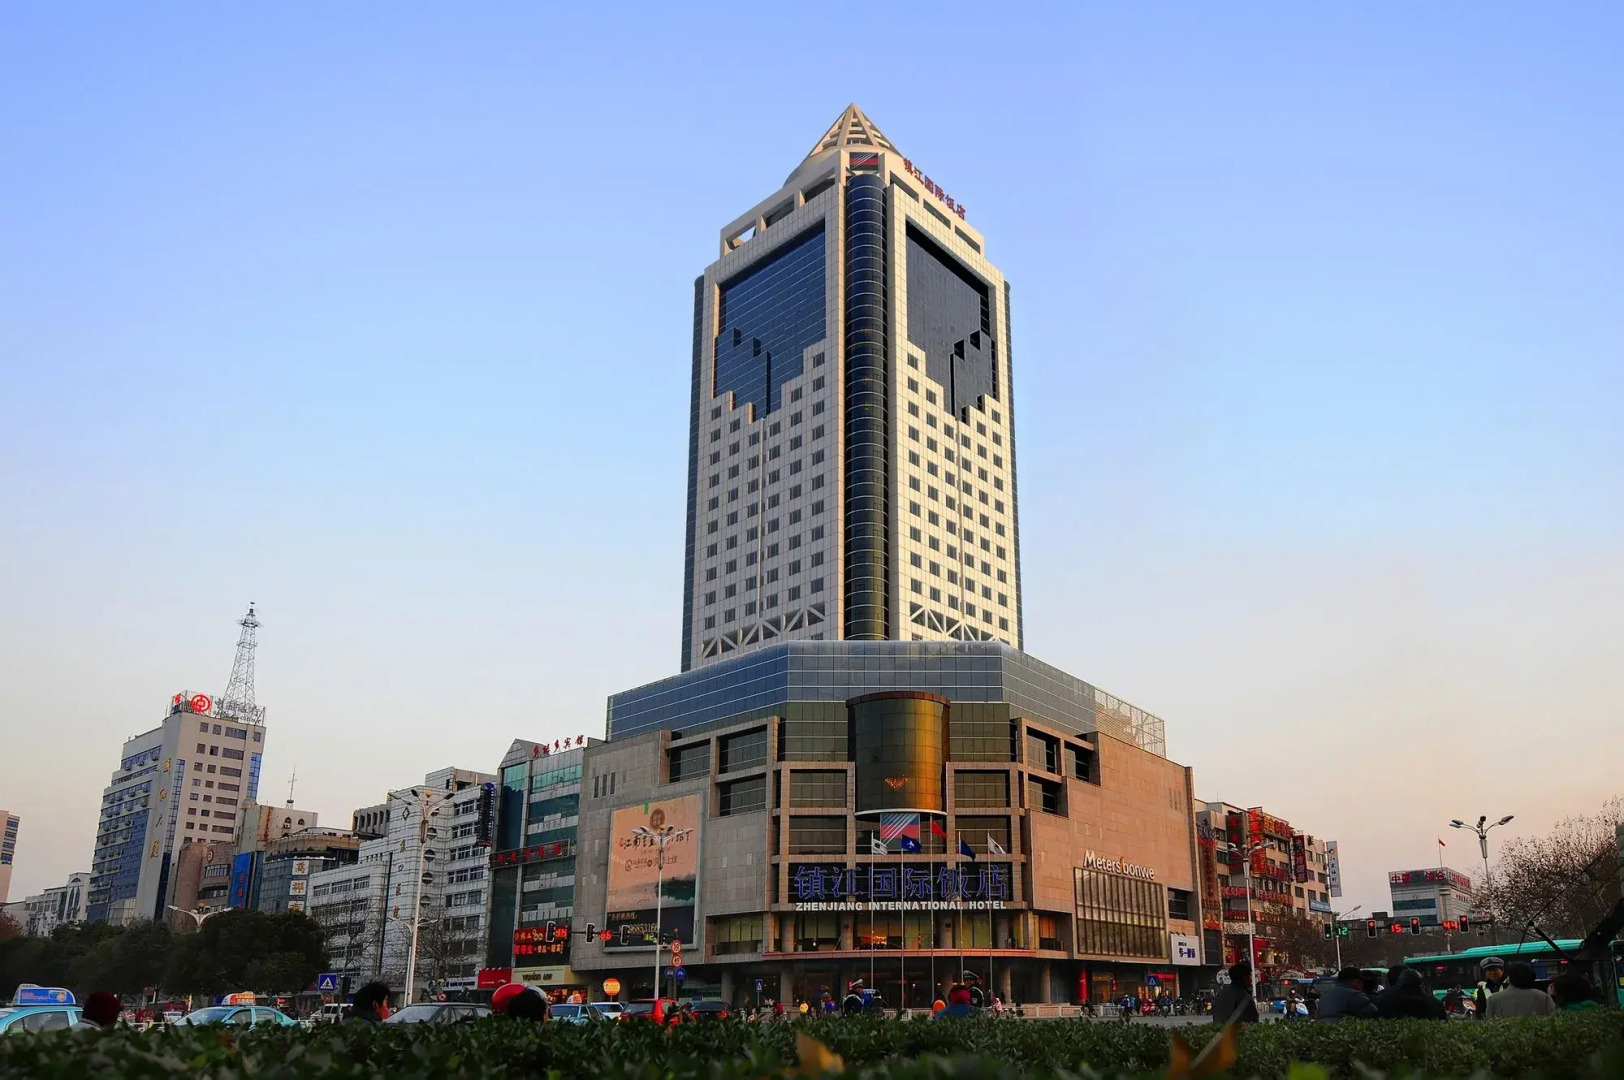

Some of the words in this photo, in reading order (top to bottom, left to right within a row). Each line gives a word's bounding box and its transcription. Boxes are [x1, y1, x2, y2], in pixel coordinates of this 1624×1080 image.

[903, 157, 966, 220] 镇江国际饭店
[794, 865, 1009, 900] 镇江国际饭店
[795, 902, 863, 911] ZHENJIANG
[868, 901, 964, 910] INTERNATIONAL
[969, 900, 1007, 910] HOTEL
[1391, 923, 1402, 932] 15
[1443, 920, 1458, 929] 44
[1338, 927, 1348, 935] 12
